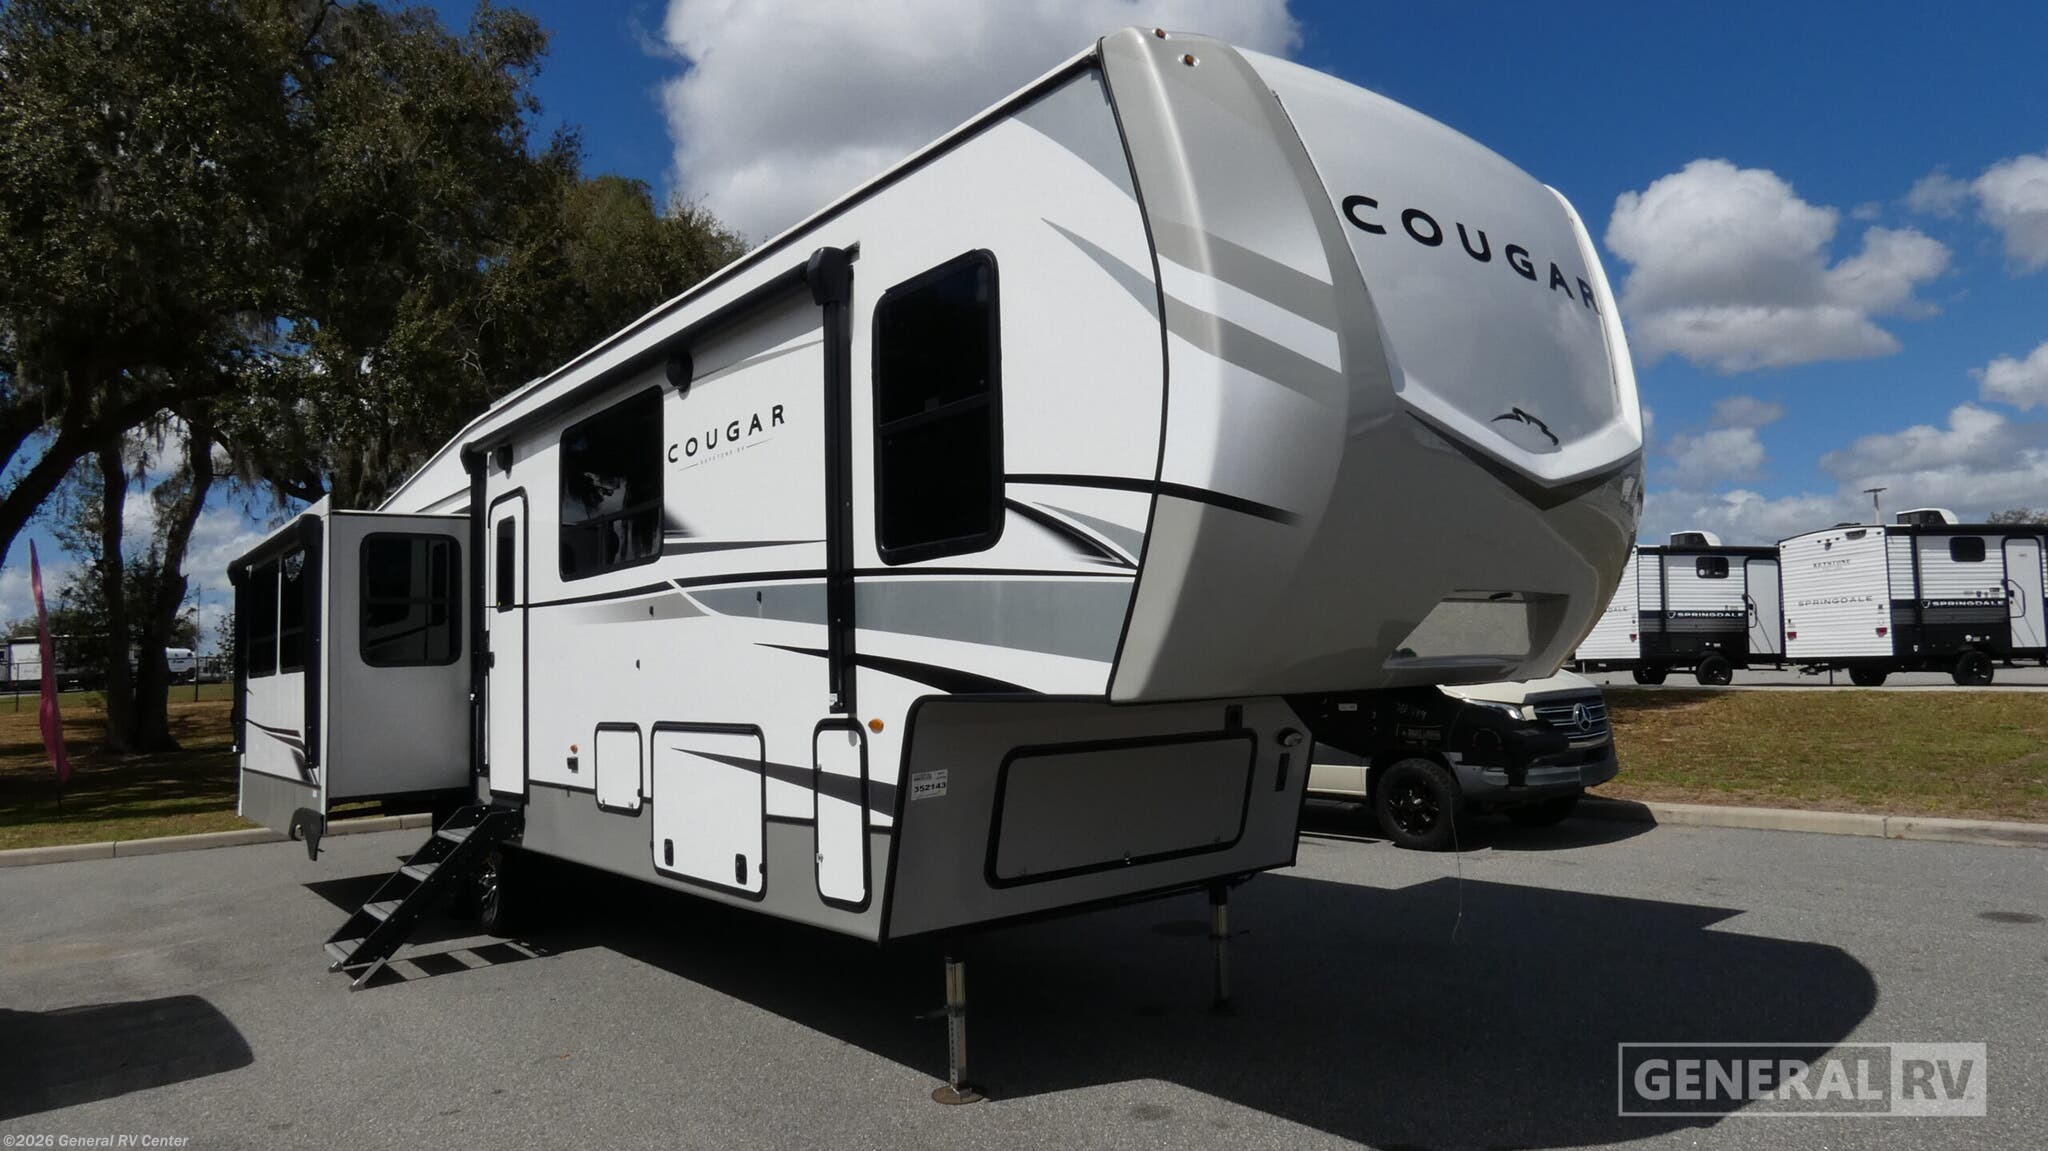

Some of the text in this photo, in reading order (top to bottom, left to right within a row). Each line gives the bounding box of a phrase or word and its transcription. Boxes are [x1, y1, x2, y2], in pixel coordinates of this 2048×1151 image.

[1341, 194, 1601, 315] COUGAR
[668, 404, 785, 463] COUGAR
[1798, 595, 1873, 607] SPRINGDALE
[914, 782, 946, 793] 352143
